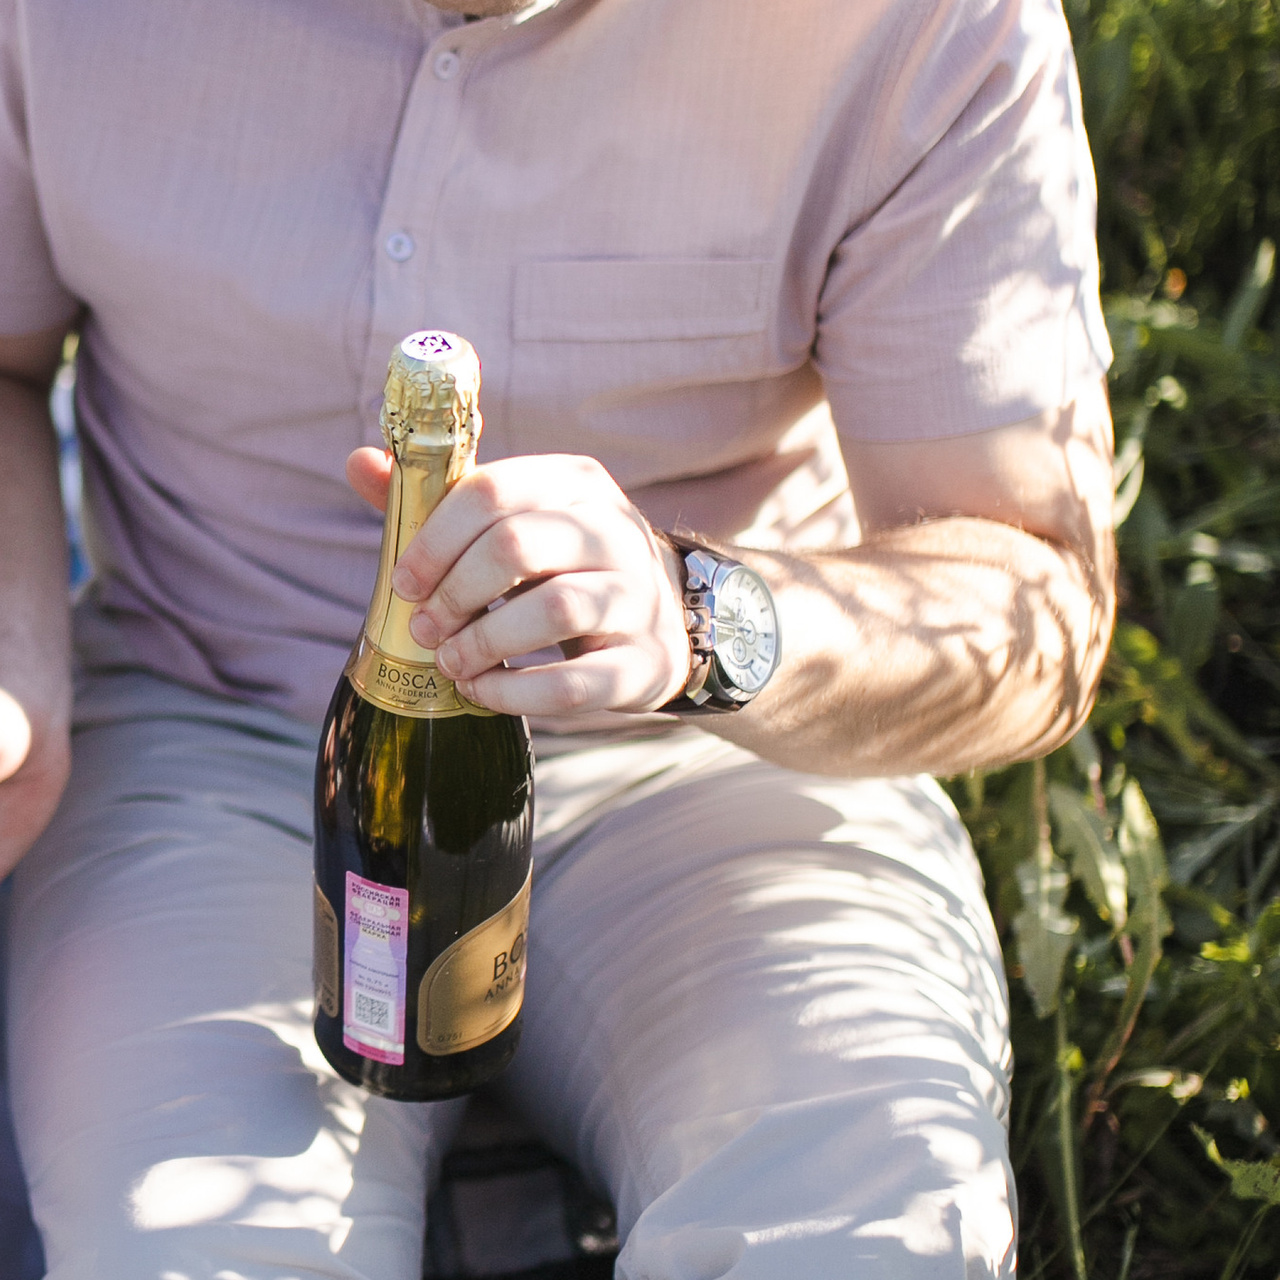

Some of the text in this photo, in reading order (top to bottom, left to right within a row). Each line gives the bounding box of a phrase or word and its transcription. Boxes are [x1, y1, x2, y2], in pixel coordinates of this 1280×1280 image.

[378, 663, 437, 690] BOSCA
[376, 679, 438, 699] ANNA FEDERICA
[352, 881, 401, 903] РОССИЙСКАЯ
